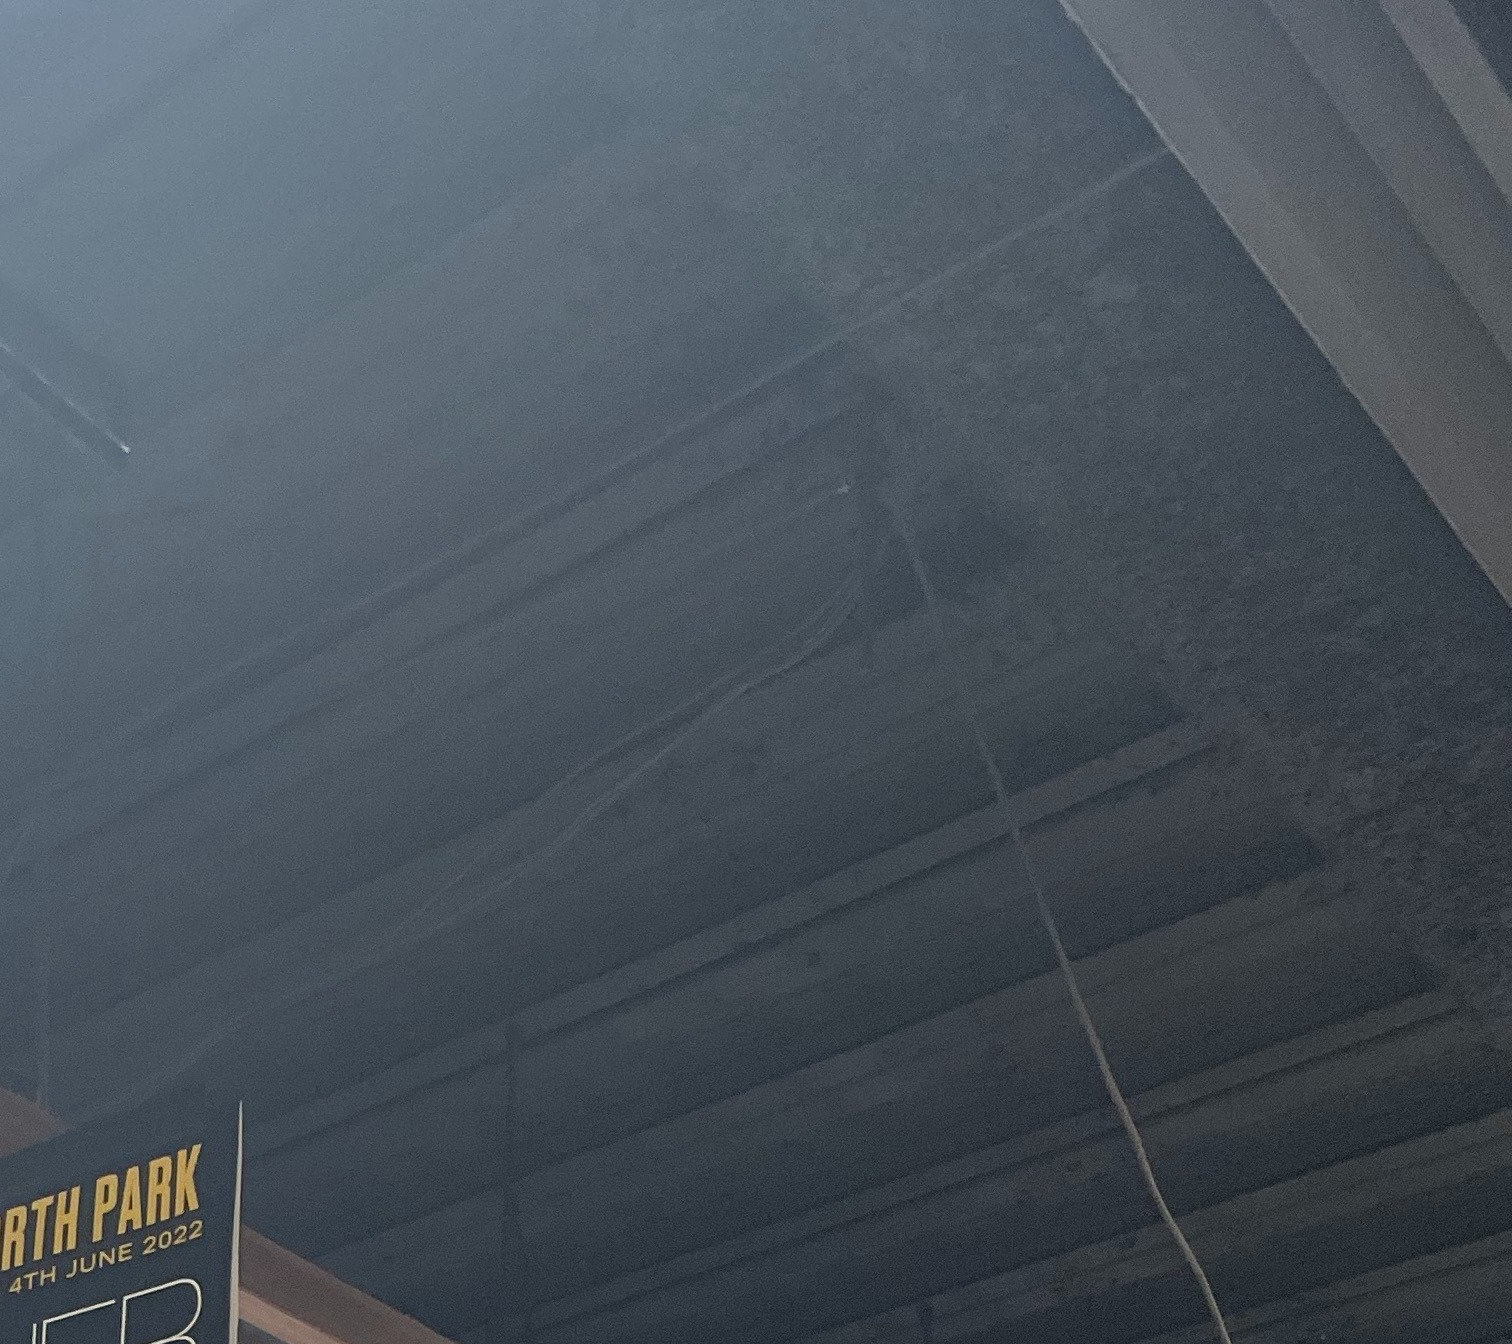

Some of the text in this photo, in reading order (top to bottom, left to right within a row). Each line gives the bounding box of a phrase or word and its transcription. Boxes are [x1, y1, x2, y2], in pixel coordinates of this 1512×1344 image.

[93, 1143, 203, 1242] PARK
[9, 1265, 57, 1296] 4TH
[65, 1243, 133, 1281] JUNE
[142, 1220, 204, 1256] 2022
